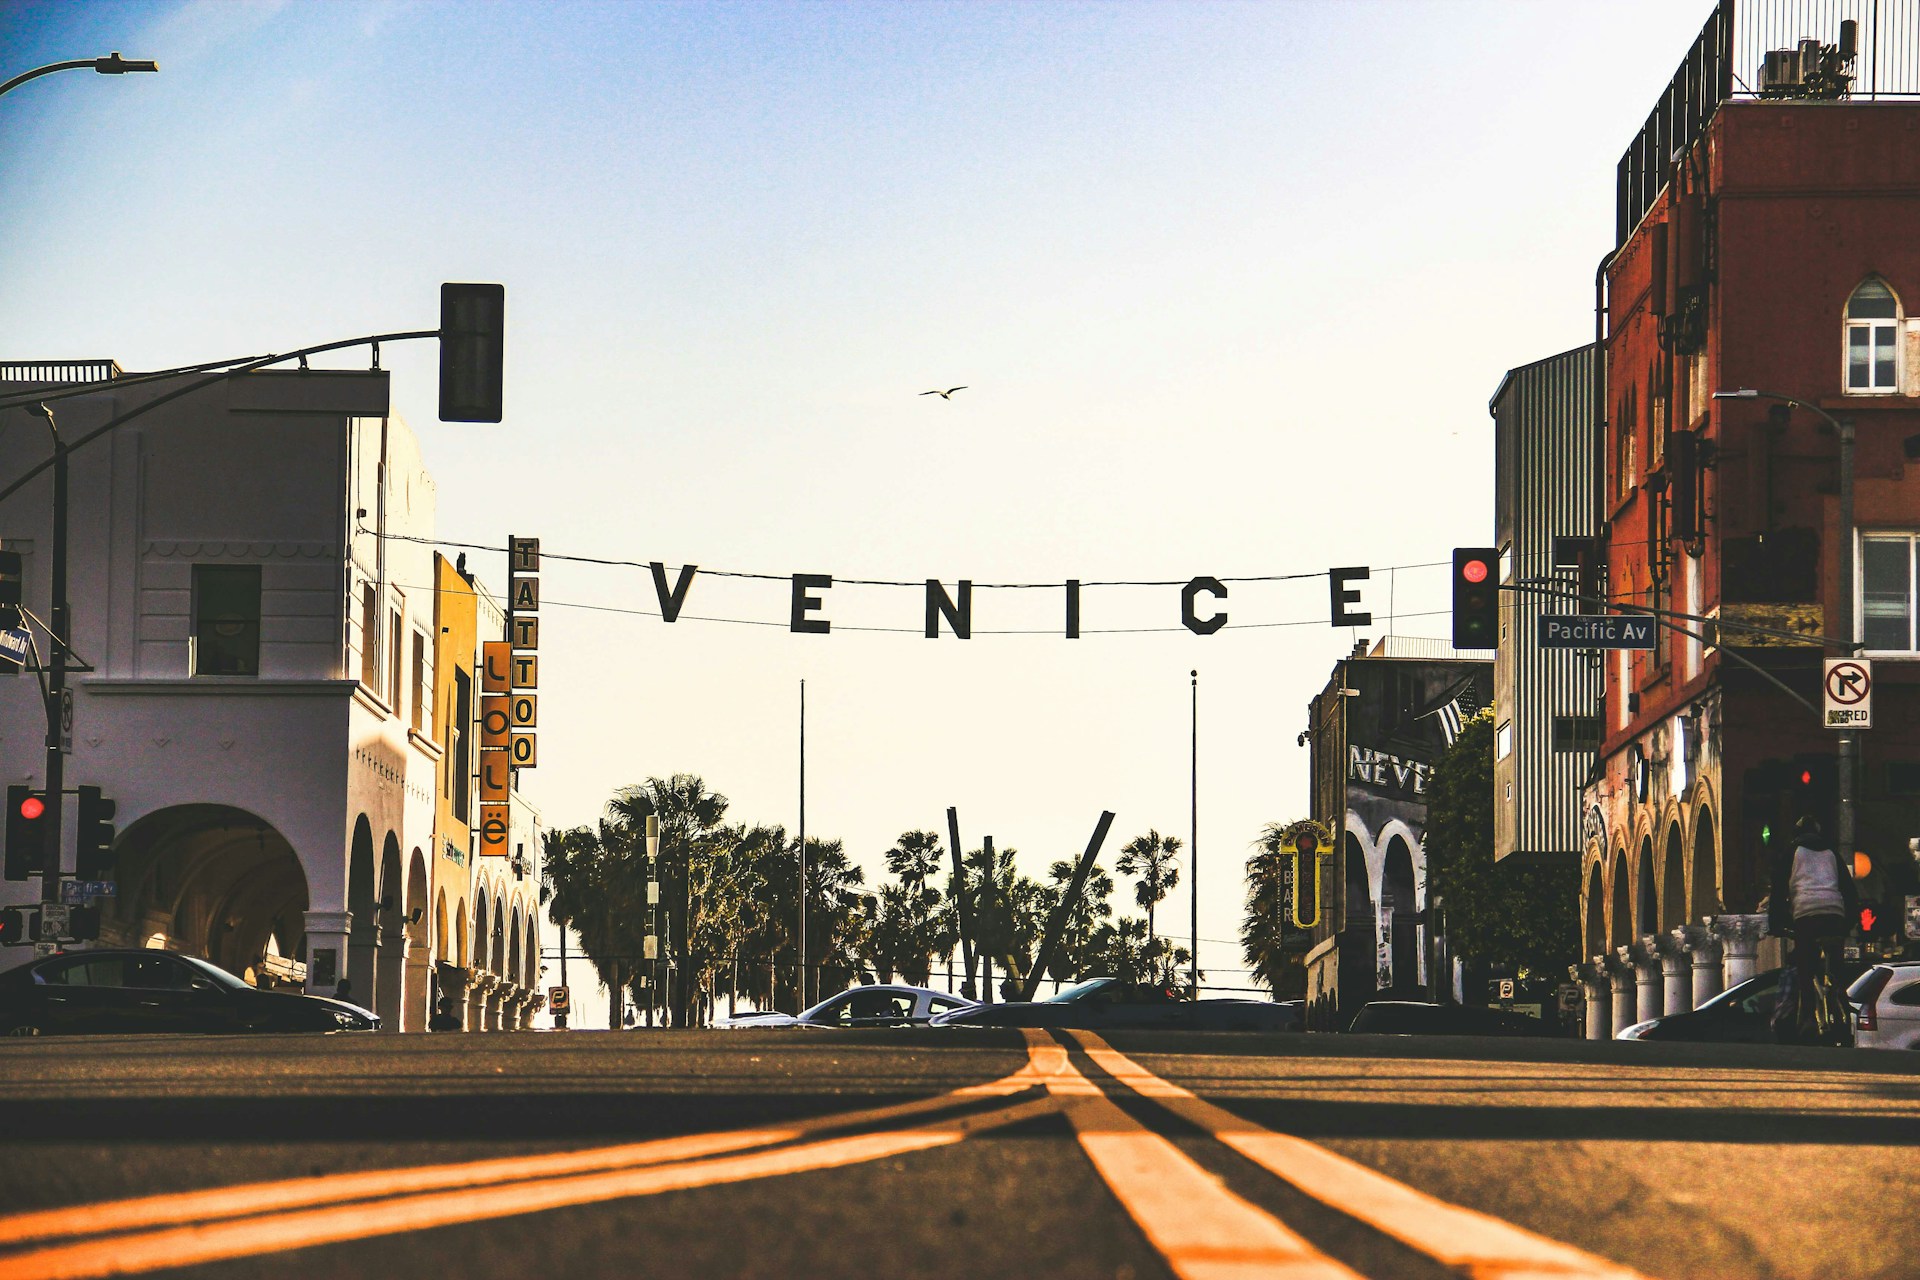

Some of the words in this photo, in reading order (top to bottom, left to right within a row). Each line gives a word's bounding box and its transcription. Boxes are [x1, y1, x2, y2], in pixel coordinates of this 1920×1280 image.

[649, 562, 1371, 639] VENICE
[1548, 622, 1616, 639] Pacific
[1622, 623, 1646, 640] Av
[515, 541, 536, 763] TATTOO
[1283, 870, 1292, 922] BAR
